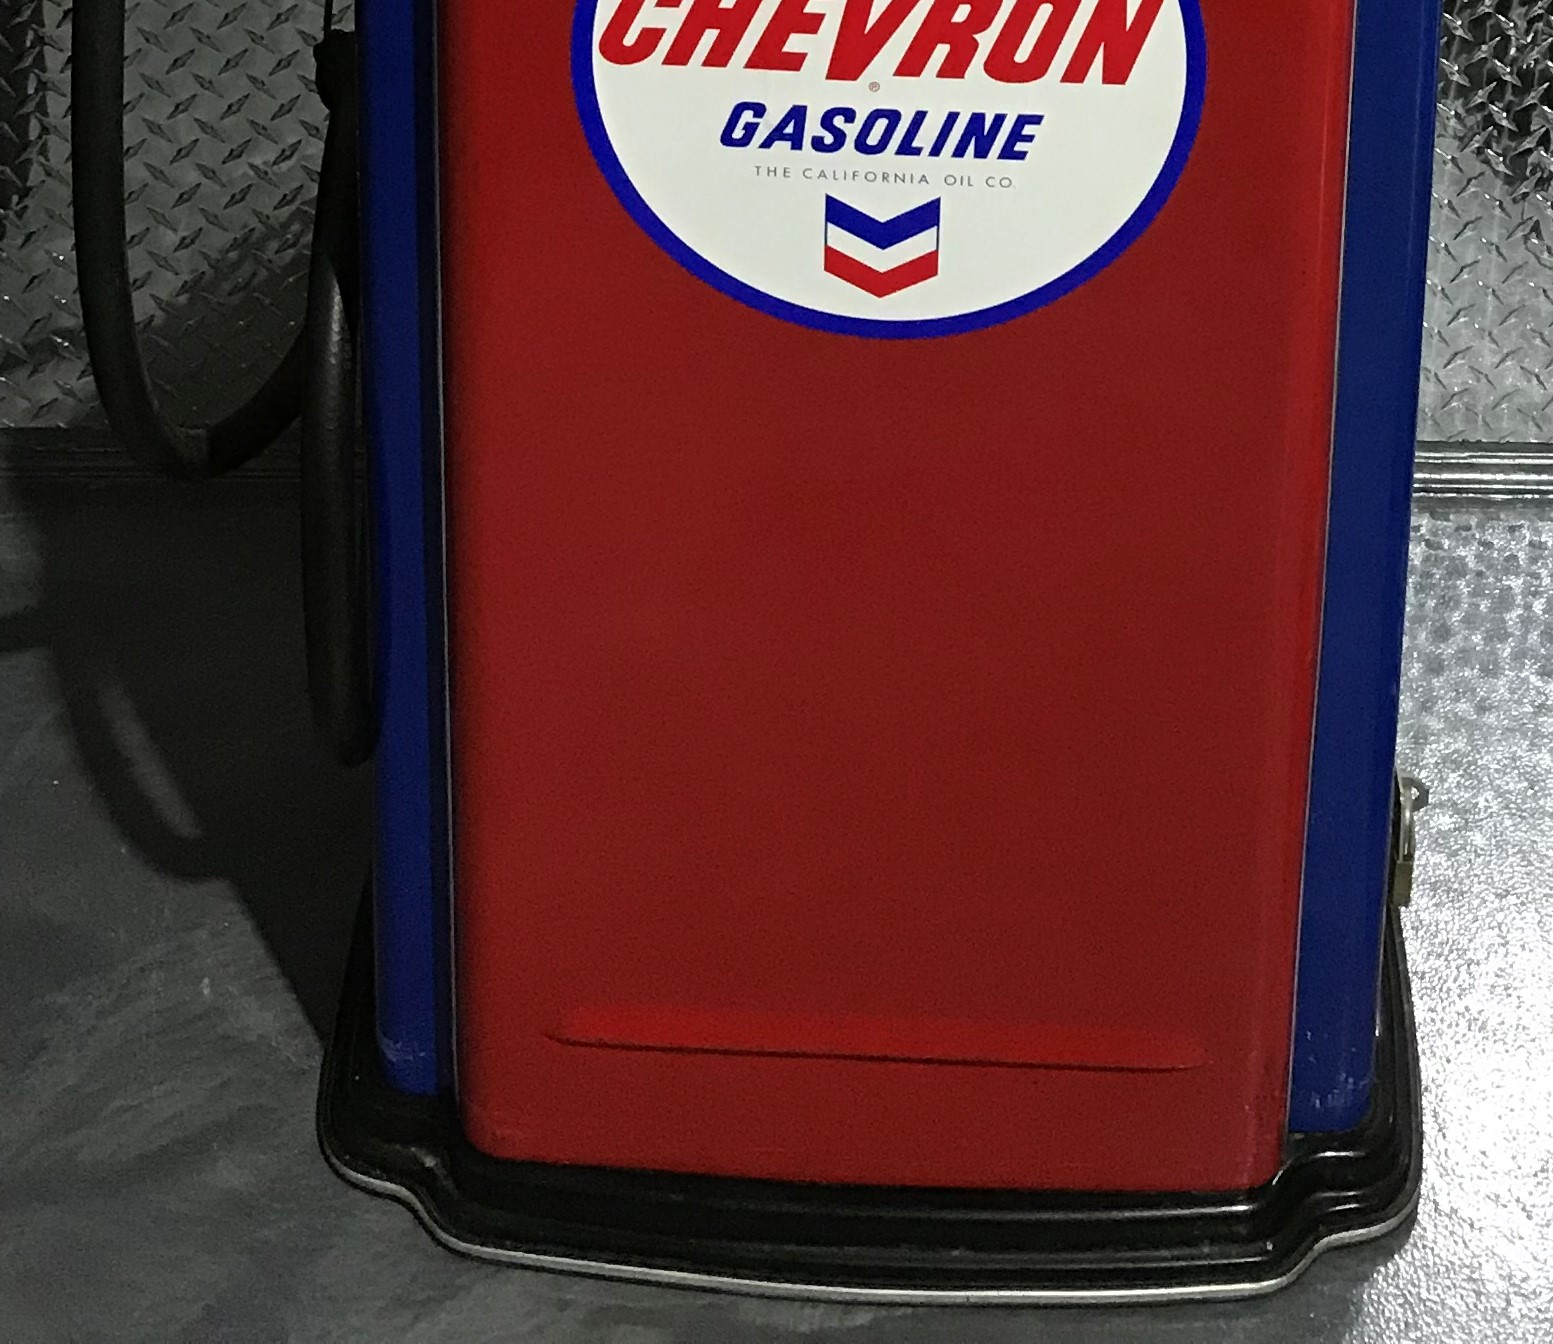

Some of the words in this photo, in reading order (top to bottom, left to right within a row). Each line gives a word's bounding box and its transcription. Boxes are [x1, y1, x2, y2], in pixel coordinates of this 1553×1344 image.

[720, 100, 1045, 161] GASOLINE
[755, 165, 792, 178] THE
[802, 168, 930, 185] CALIFORNIA
[943, 174, 974, 187] OIL
